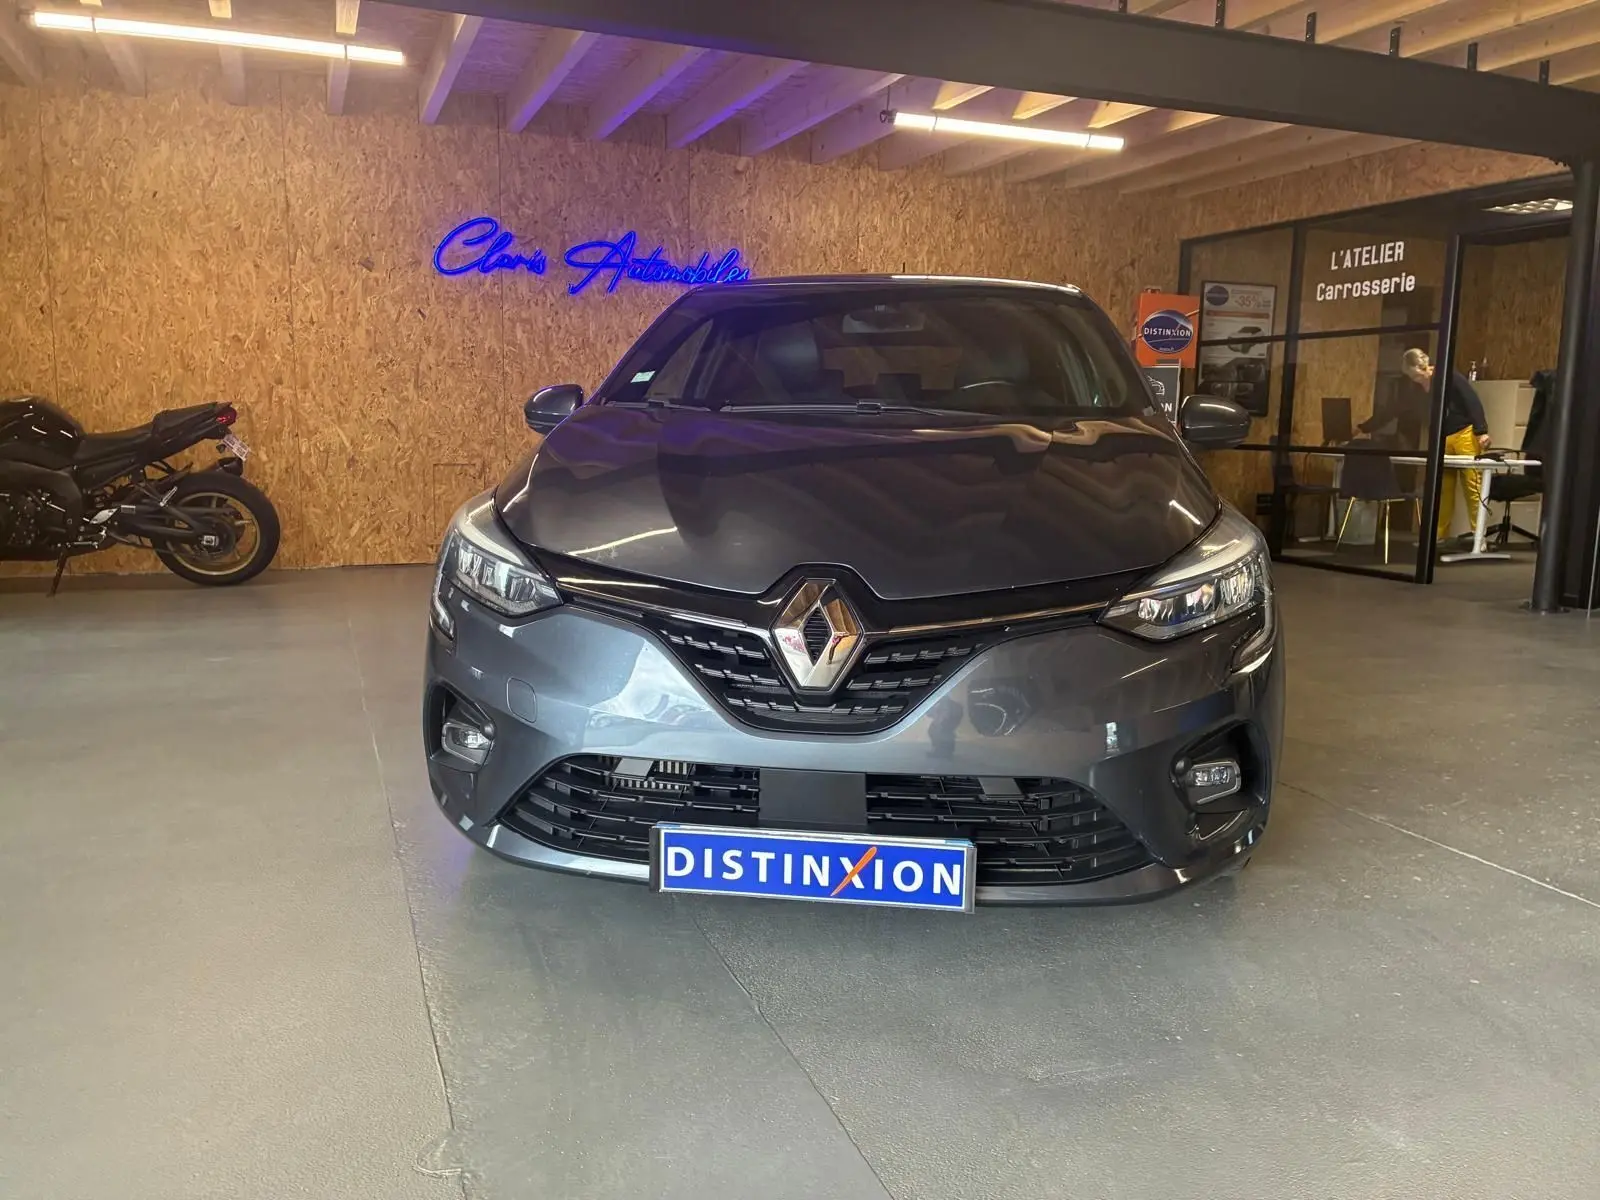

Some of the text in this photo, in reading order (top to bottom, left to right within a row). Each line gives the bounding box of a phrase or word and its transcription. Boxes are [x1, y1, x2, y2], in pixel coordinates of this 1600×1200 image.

[565, 231, 749, 294] Automobiles
[1331, 241, 1404, 270] L'ATELIER
[1316, 273, 1416, 301] Carrosserie
[1144, 327, 1191, 337] DISTINXION
[666, 846, 960, 896] DISTINXION
